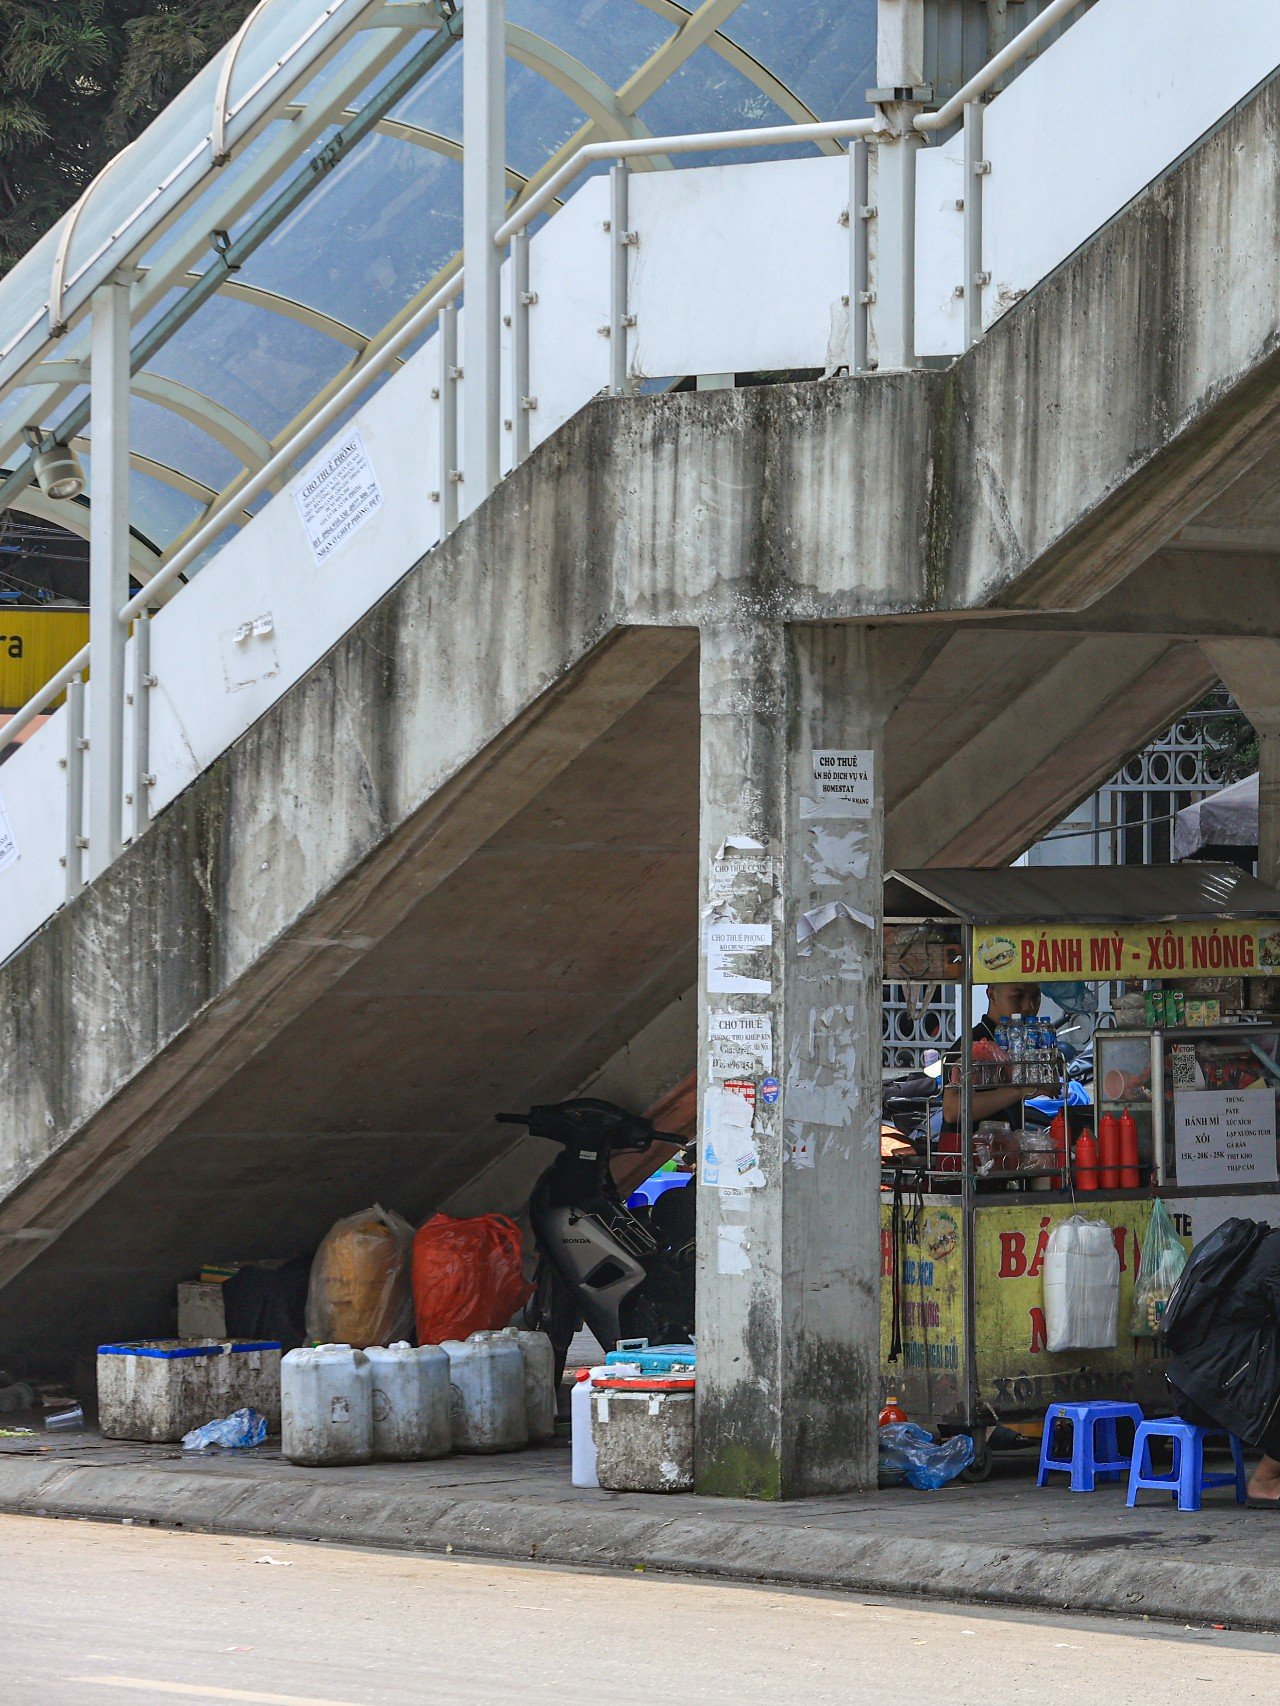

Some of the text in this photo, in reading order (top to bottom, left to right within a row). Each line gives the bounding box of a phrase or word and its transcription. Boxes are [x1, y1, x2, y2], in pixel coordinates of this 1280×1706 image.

[820, 755, 857, 767] CHO THUÊ
[823, 770, 831, 781] HỘ
[833, 772, 847, 781] DỊCH
[849, 772, 857, 781] VỤ
[859, 771, 868, 780] VÀ
[712, 933, 765, 942] CHO THUÊ PHÒNG
[1021, 932, 1083, 974] BÁNH
[1090, 930, 1124, 971] MỲ
[1149, 929, 1184, 970] XÔI
[1192, 928, 1255, 969] NÓNG
[719, 1017, 762, 1029] CHO THUÊ
[1185, 1116, 1207, 1126] BÁNH
[1195, 1133, 1210, 1143] XÔI
[1213, 1151, 1225, 1159] 25K
